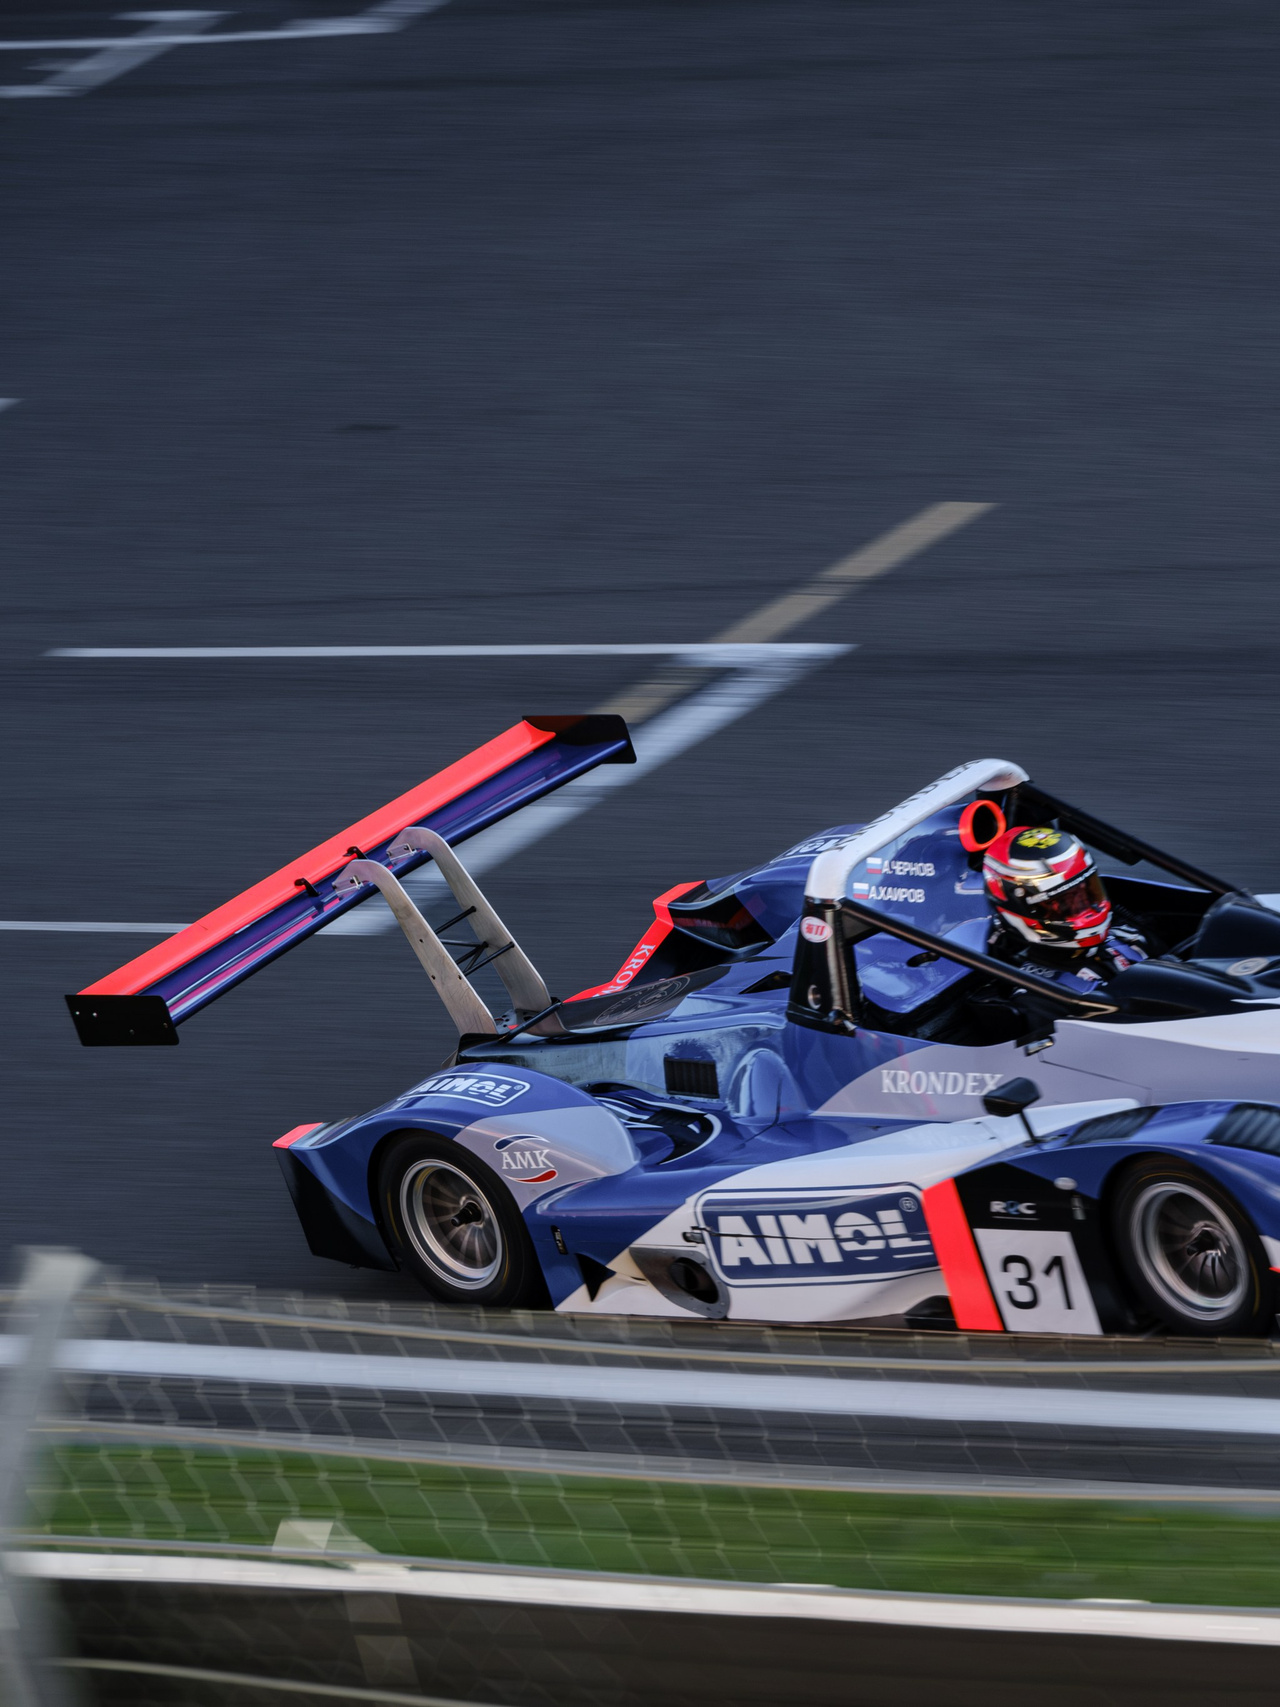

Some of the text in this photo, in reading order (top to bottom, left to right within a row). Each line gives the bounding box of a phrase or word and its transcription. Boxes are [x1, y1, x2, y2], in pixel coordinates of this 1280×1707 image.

[408, 1077, 513, 1102] AIMOL
[881, 1069, 1003, 1097] KRONDEX
[501, 1149, 555, 1170] AMK
[718, 1208, 934, 1266] AIMOL
[1001, 1254, 1074, 1311] 31
